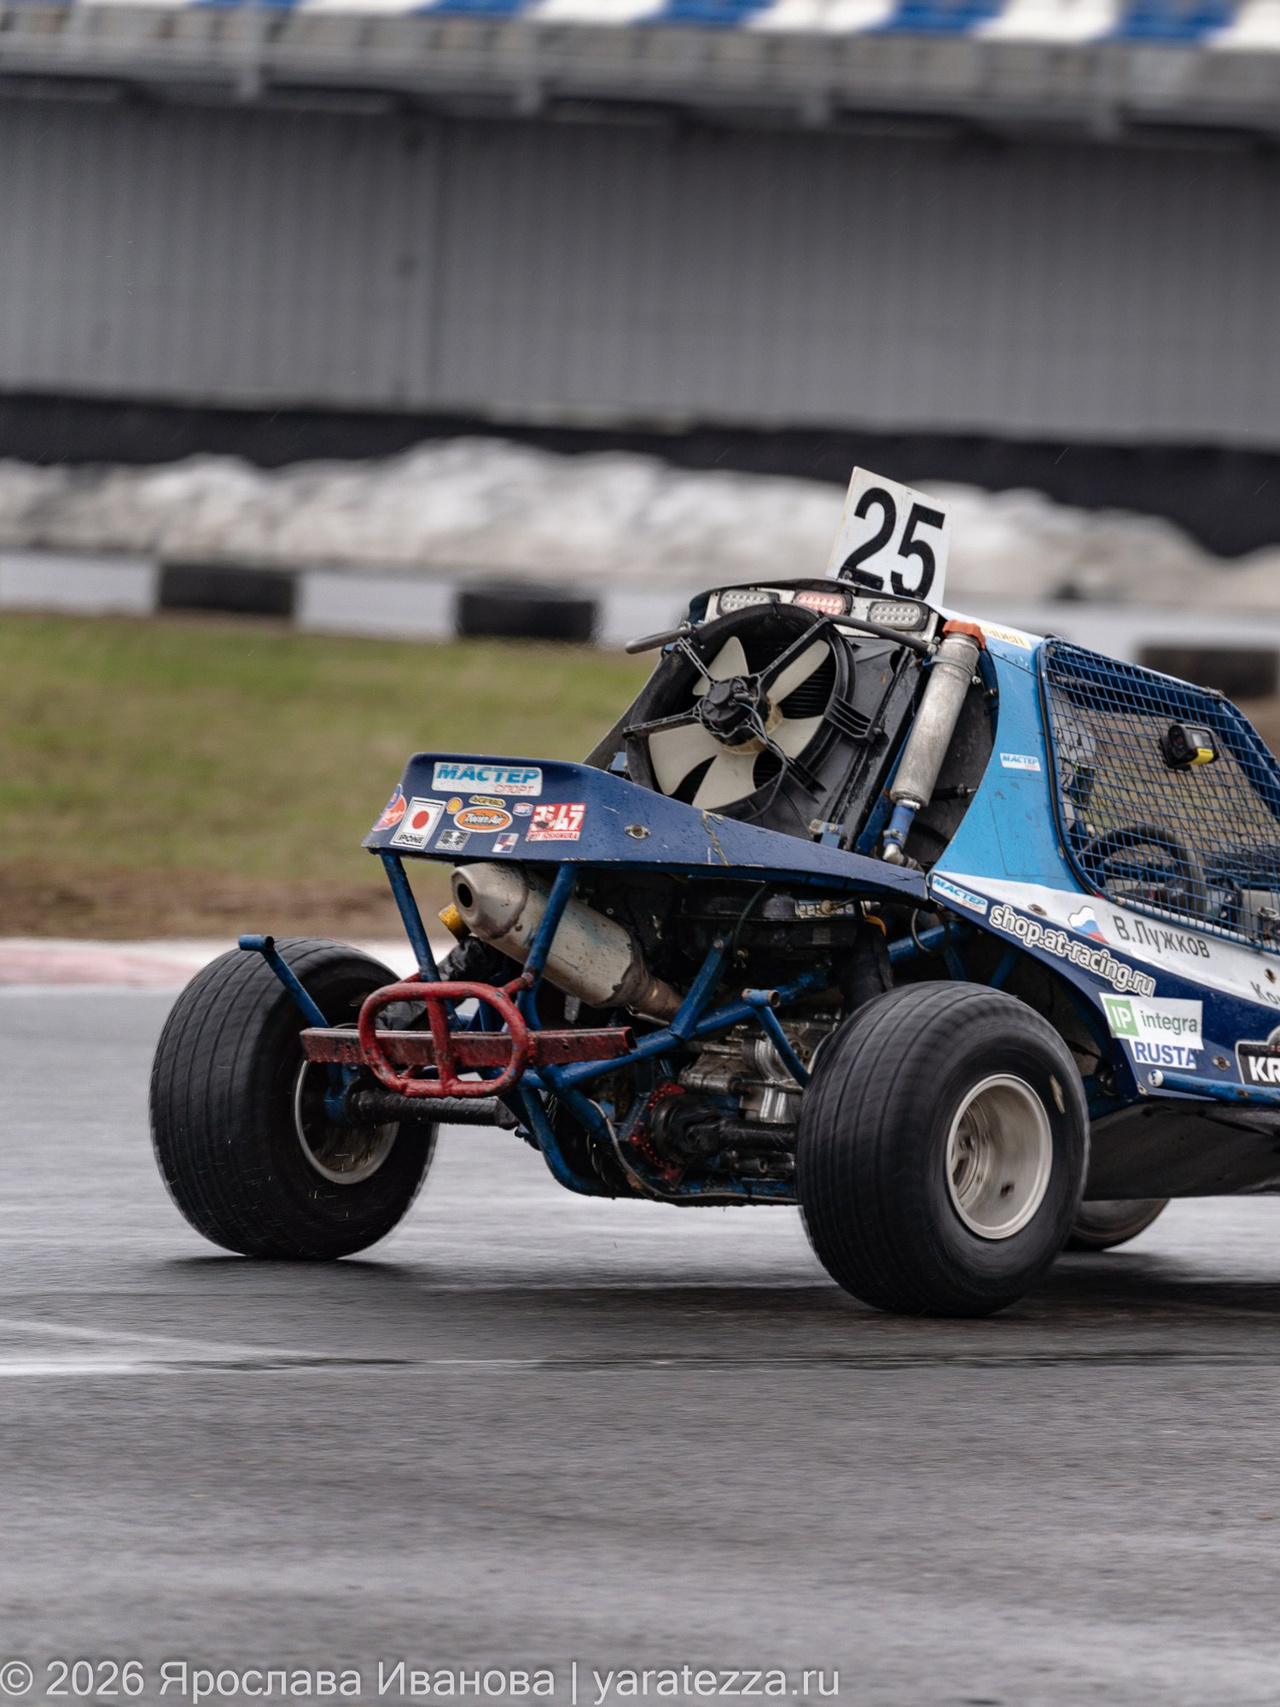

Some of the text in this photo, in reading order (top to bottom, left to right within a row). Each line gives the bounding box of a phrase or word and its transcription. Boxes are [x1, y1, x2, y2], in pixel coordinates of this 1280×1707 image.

[838, 487, 946, 601] 25
[437, 764, 540, 784] МАСТЕР
[933, 878, 986, 905] МАСТЕР
[990, 904, 1156, 997] shop.at-racing.ru
[1110, 1004, 1198, 1035] IP integra
